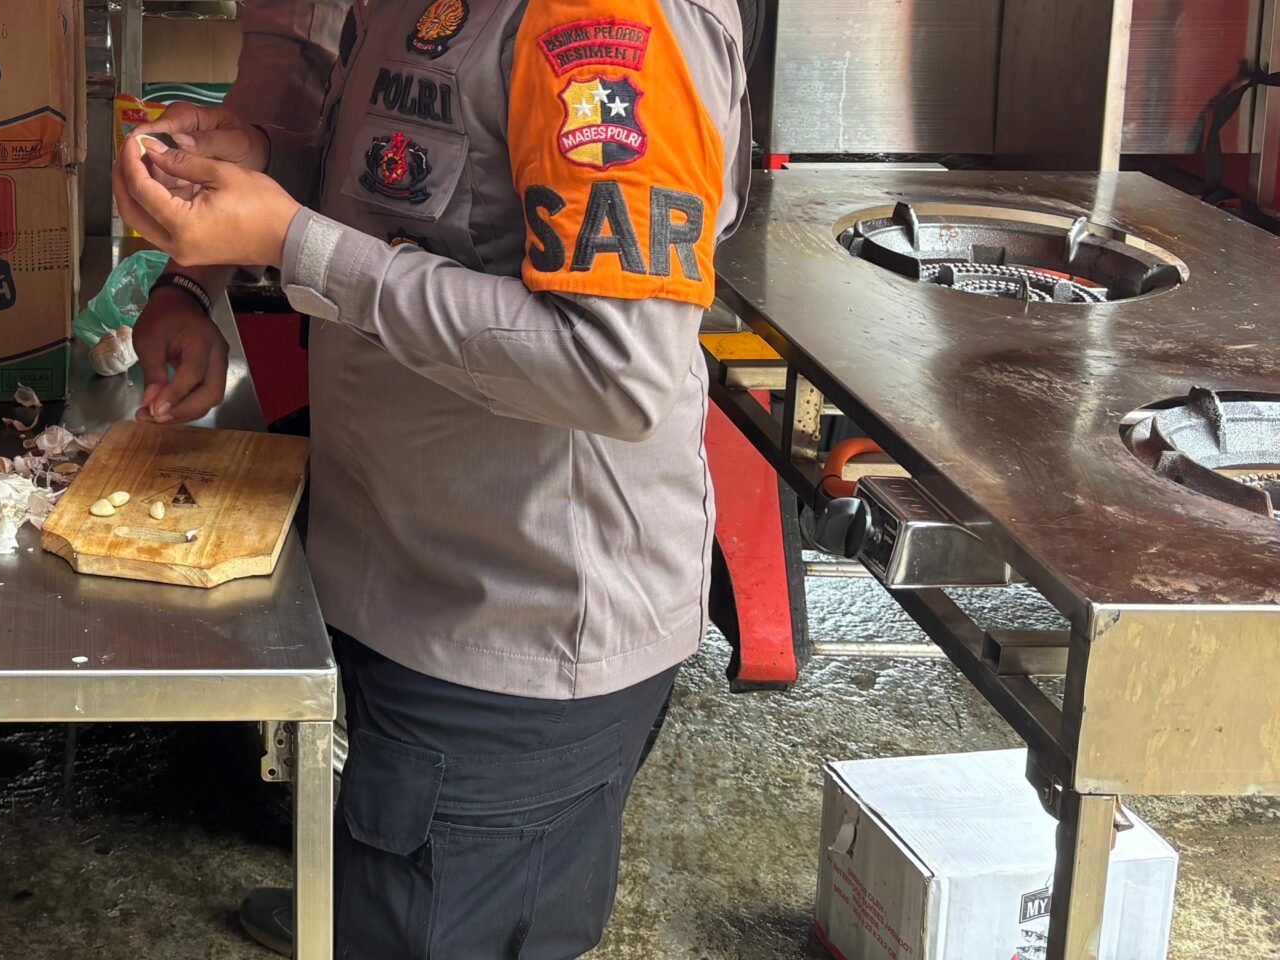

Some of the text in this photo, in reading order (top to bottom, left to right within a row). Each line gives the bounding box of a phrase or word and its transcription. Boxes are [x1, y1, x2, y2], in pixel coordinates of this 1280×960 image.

[556, 45, 628, 66] RESIMEN
[370, 67, 453, 125] POLRI
[562, 126, 642, 150] MABES POLRI
[524, 179, 704, 281] SAR
